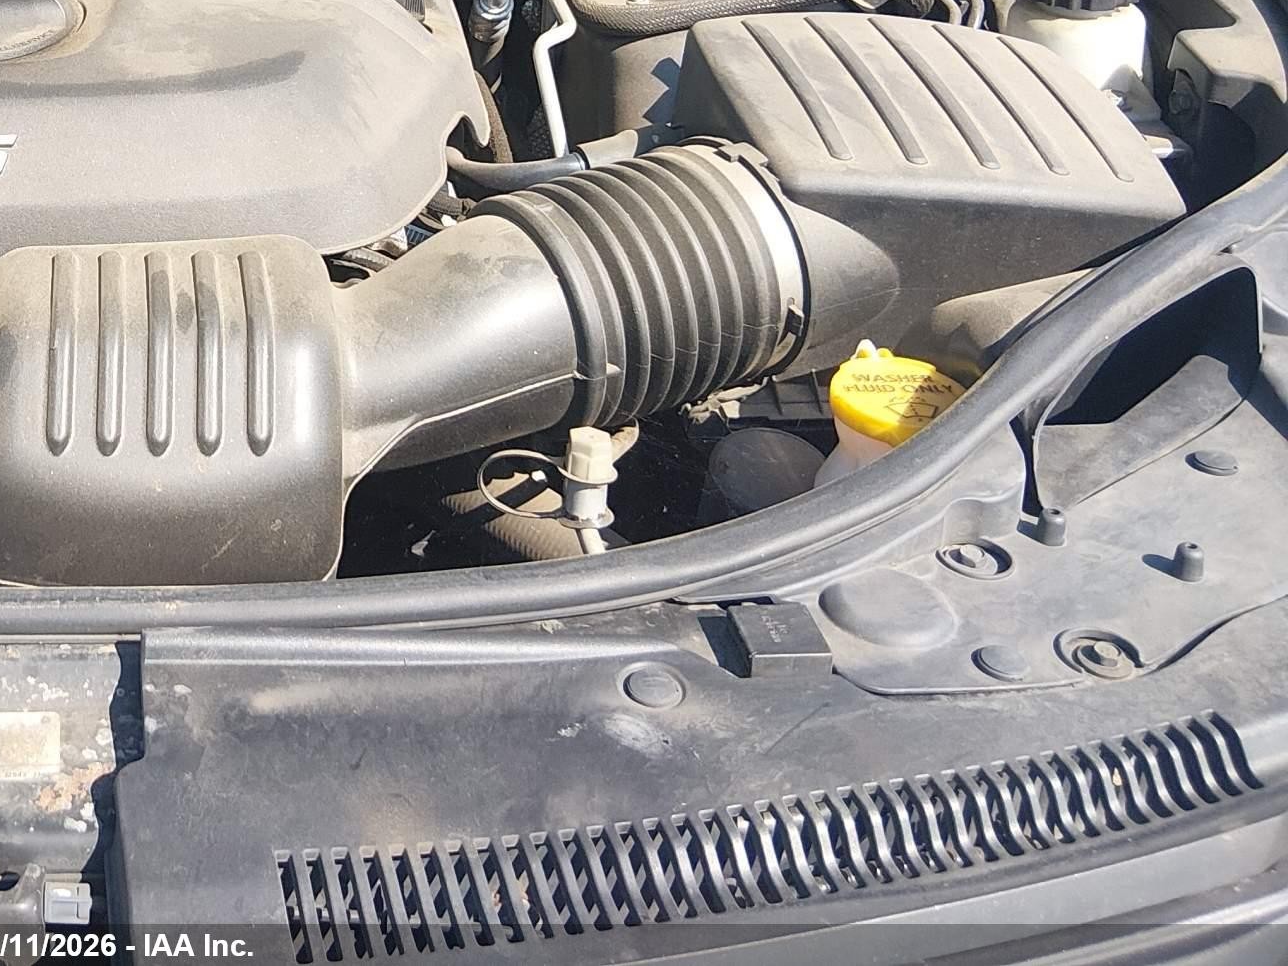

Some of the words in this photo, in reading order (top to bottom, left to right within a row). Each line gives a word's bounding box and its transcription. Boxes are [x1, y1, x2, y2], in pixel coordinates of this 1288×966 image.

[852, 374, 934, 383] WASHER
[843, 385, 896, 393] FLUID
[902, 385, 953, 393] ONLY
